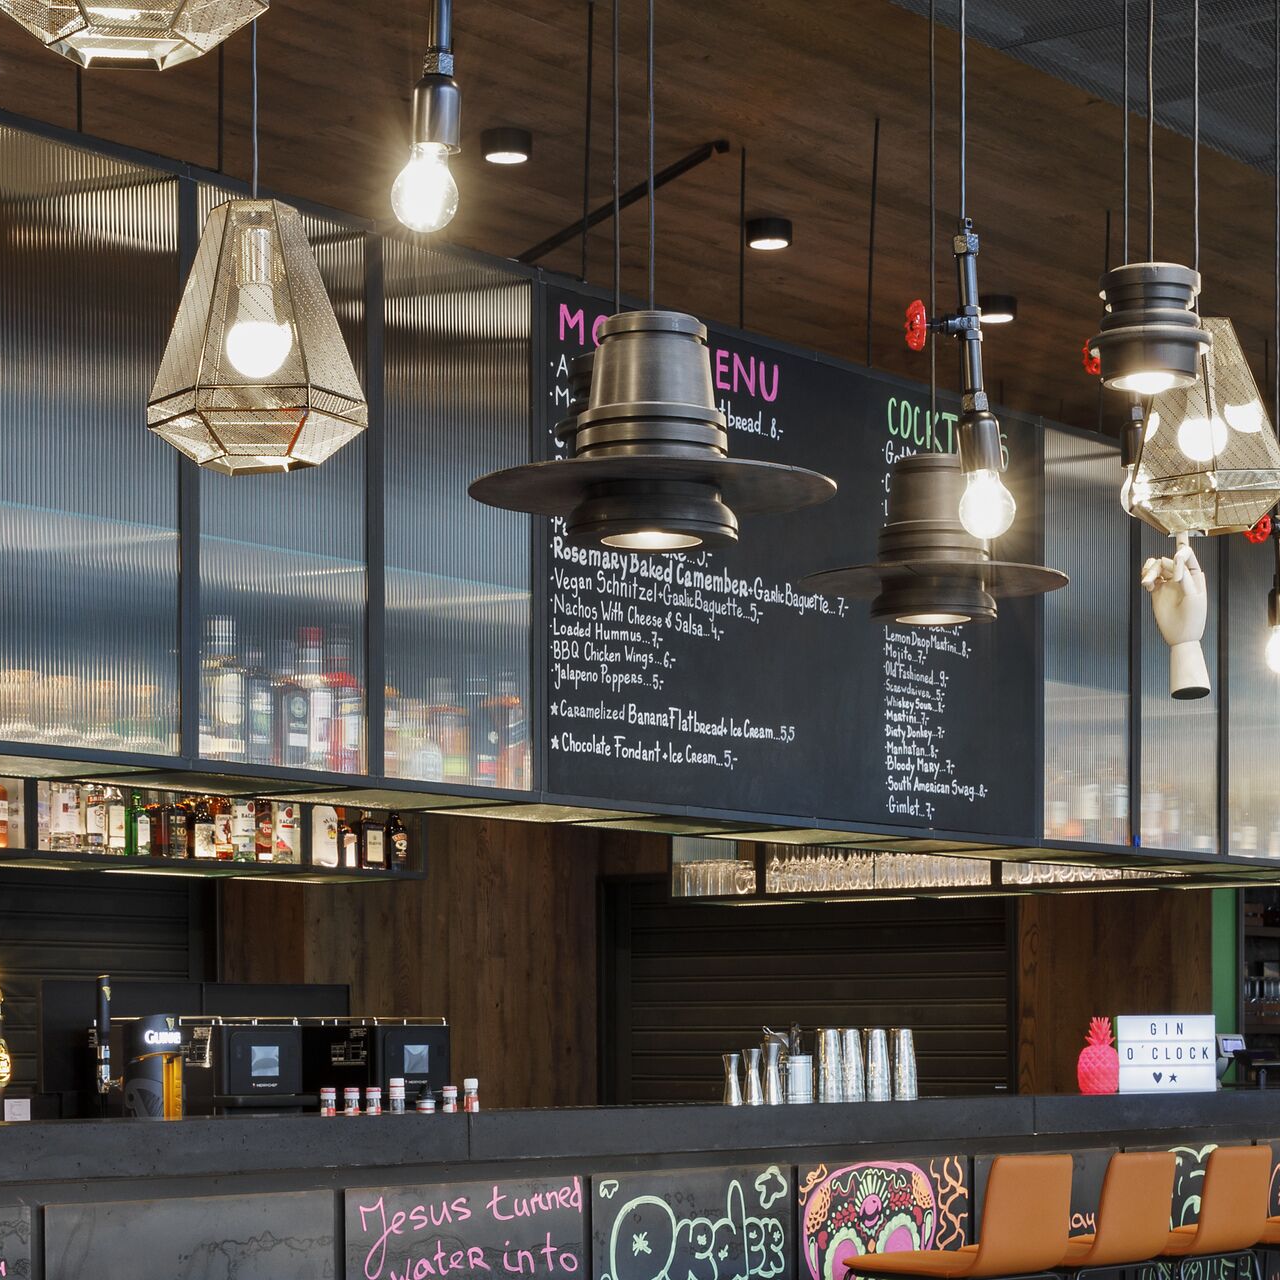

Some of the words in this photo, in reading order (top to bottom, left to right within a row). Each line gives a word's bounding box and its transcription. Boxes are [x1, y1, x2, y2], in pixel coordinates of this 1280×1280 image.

[716, 348, 779, 403] ENU
[554, 536, 627, 580] Rosemary
[630, 553, 673, 584] Baked
[554, 567, 592, 599] Vegan
[554, 593, 598, 621] Nachos
[600, 600, 624, 622] With
[627, 605, 663, 629] Cheese
[553, 617, 591, 638] Loaded
[885, 625, 911, 645] Lemon
[911, 631, 931, 654] Drop
[553, 639, 580, 661] BBQ
[584, 641, 621, 663] Chicken
[554, 662, 598, 690] Jalapeno
[885, 660, 897, 678] Old
[560, 699, 625, 721] Caramelized
[628, 703, 669, 728] Banana
[730, 718, 742, 738] Ice
[885, 695, 915, 714] Whiskey
[885, 724, 906, 743] Dirty
[562, 732, 611, 757] Chocolate
[614, 735, 661, 763] Fondant
[669, 741, 683, 764] Ice
[886, 755, 915, 780] Bloody
[887, 775, 912, 791] South
[913, 776, 950, 794] American
[1150, 1022, 1184, 1036] GIN
[359, 1193, 473, 1280] Jesus
[486, 1175, 582, 1222] turned
